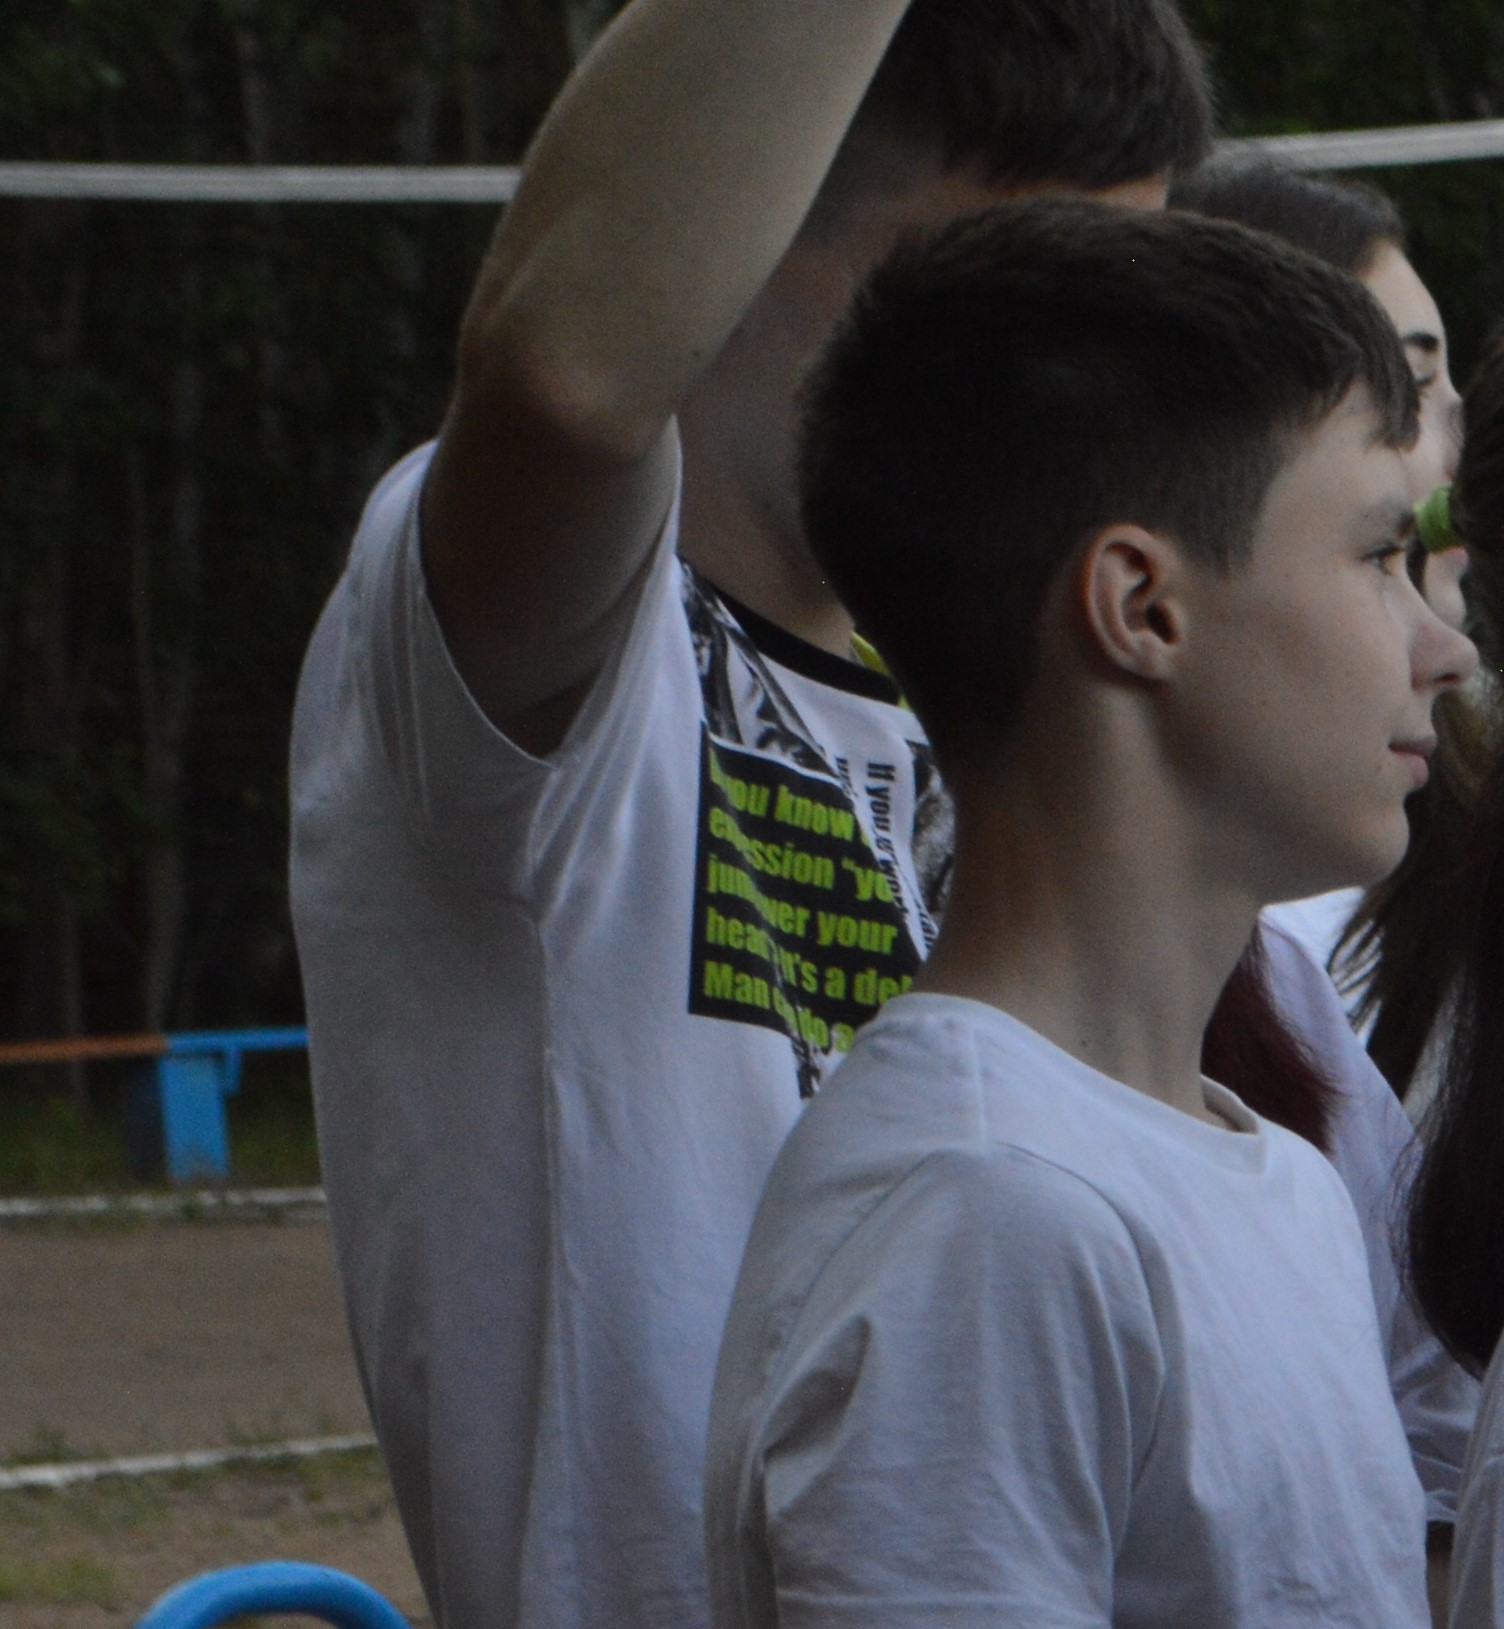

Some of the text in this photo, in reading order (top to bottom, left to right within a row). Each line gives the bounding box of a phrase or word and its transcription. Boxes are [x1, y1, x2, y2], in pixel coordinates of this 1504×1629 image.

[774, 783, 855, 842] know
[816, 910, 899, 956] your
[704, 959, 771, 1010] Man
